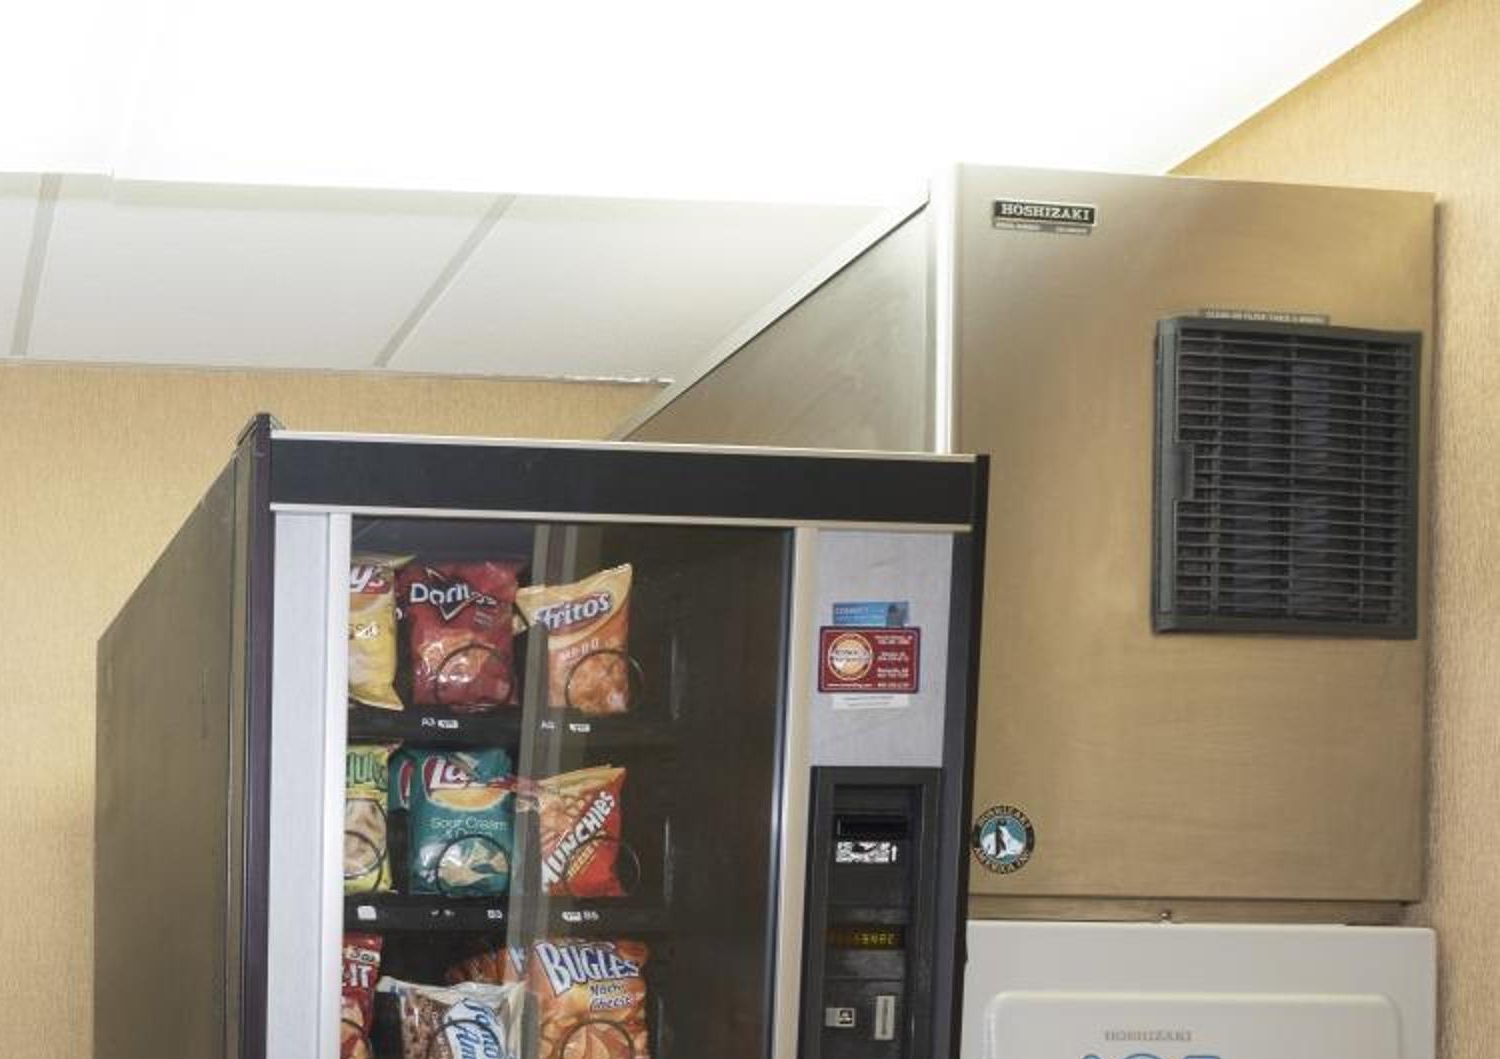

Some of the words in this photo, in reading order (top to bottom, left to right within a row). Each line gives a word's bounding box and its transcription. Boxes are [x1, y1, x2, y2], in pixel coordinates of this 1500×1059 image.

[1001, 203, 1089, 221] HOSHIZAKI
[535, 593, 610, 630] Fritos
[535, 943, 640, 996] BUGLES
[1104, 1030, 1192, 1041] HOSHIZAKI
